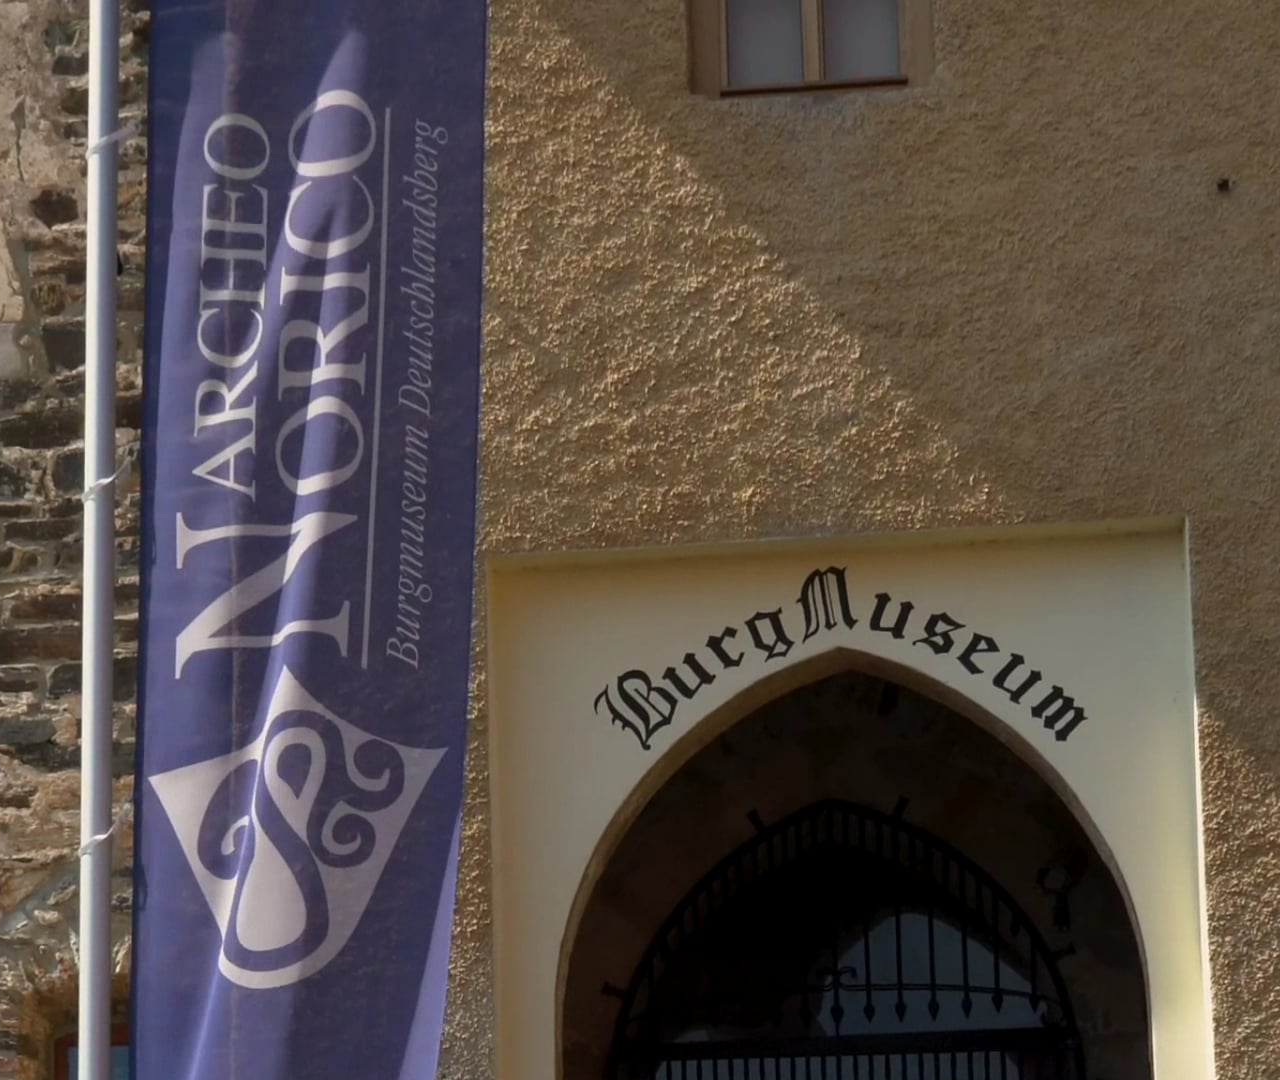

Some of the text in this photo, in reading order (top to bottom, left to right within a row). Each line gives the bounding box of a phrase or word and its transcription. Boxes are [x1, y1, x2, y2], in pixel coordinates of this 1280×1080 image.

[174, 88, 378, 681] NORICO
[191, 112, 271, 504] ARCHEO
[386, 118, 449, 670] Burgmuseum Deutschlandsberg
[593, 565, 1089, 751] BurgMuseum
